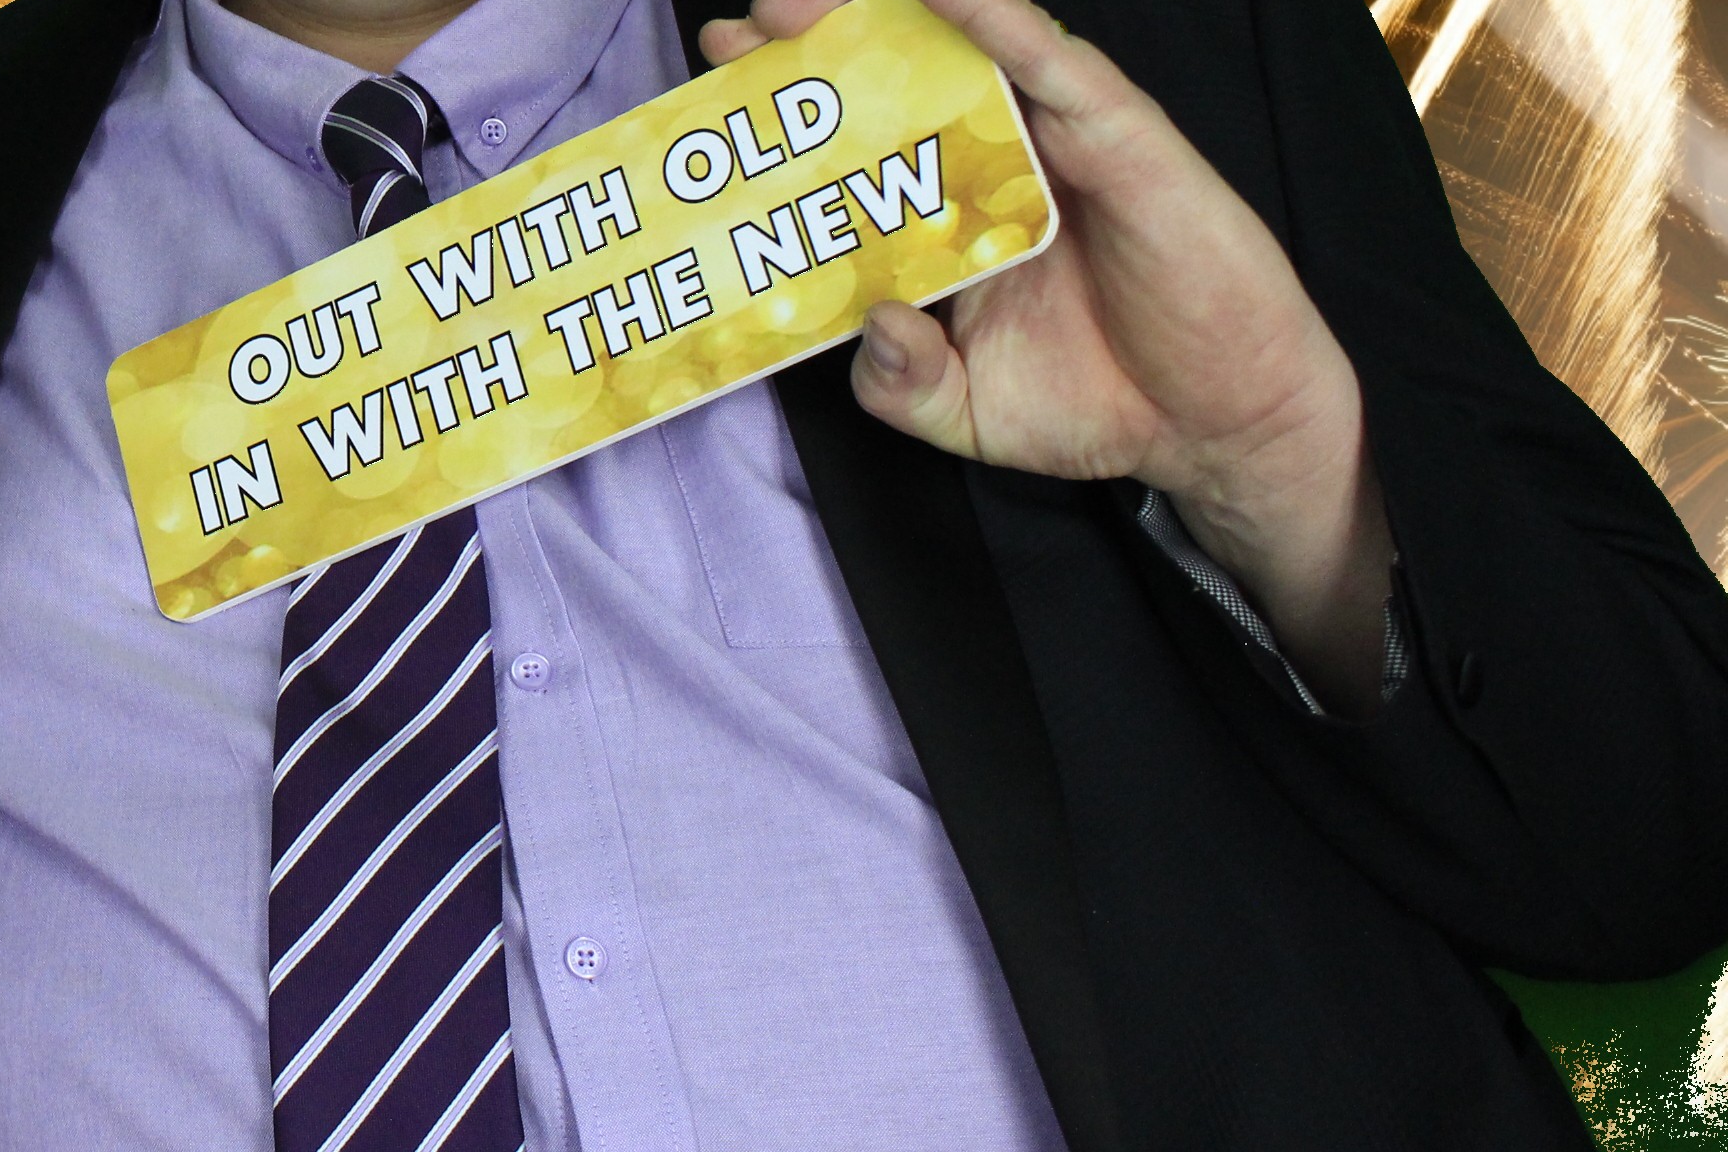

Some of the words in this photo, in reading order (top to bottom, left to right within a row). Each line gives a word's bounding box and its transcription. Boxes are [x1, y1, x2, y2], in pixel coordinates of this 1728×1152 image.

[189, 440, 282, 534] IN
[298, 332, 528, 481] WITH
[546, 248, 713, 374] THE
[730, 133, 946, 295] NEW
[227, 283, 382, 405] OUT
[407, 167, 641, 321] WITH
[662, 75, 843, 205] OLD
